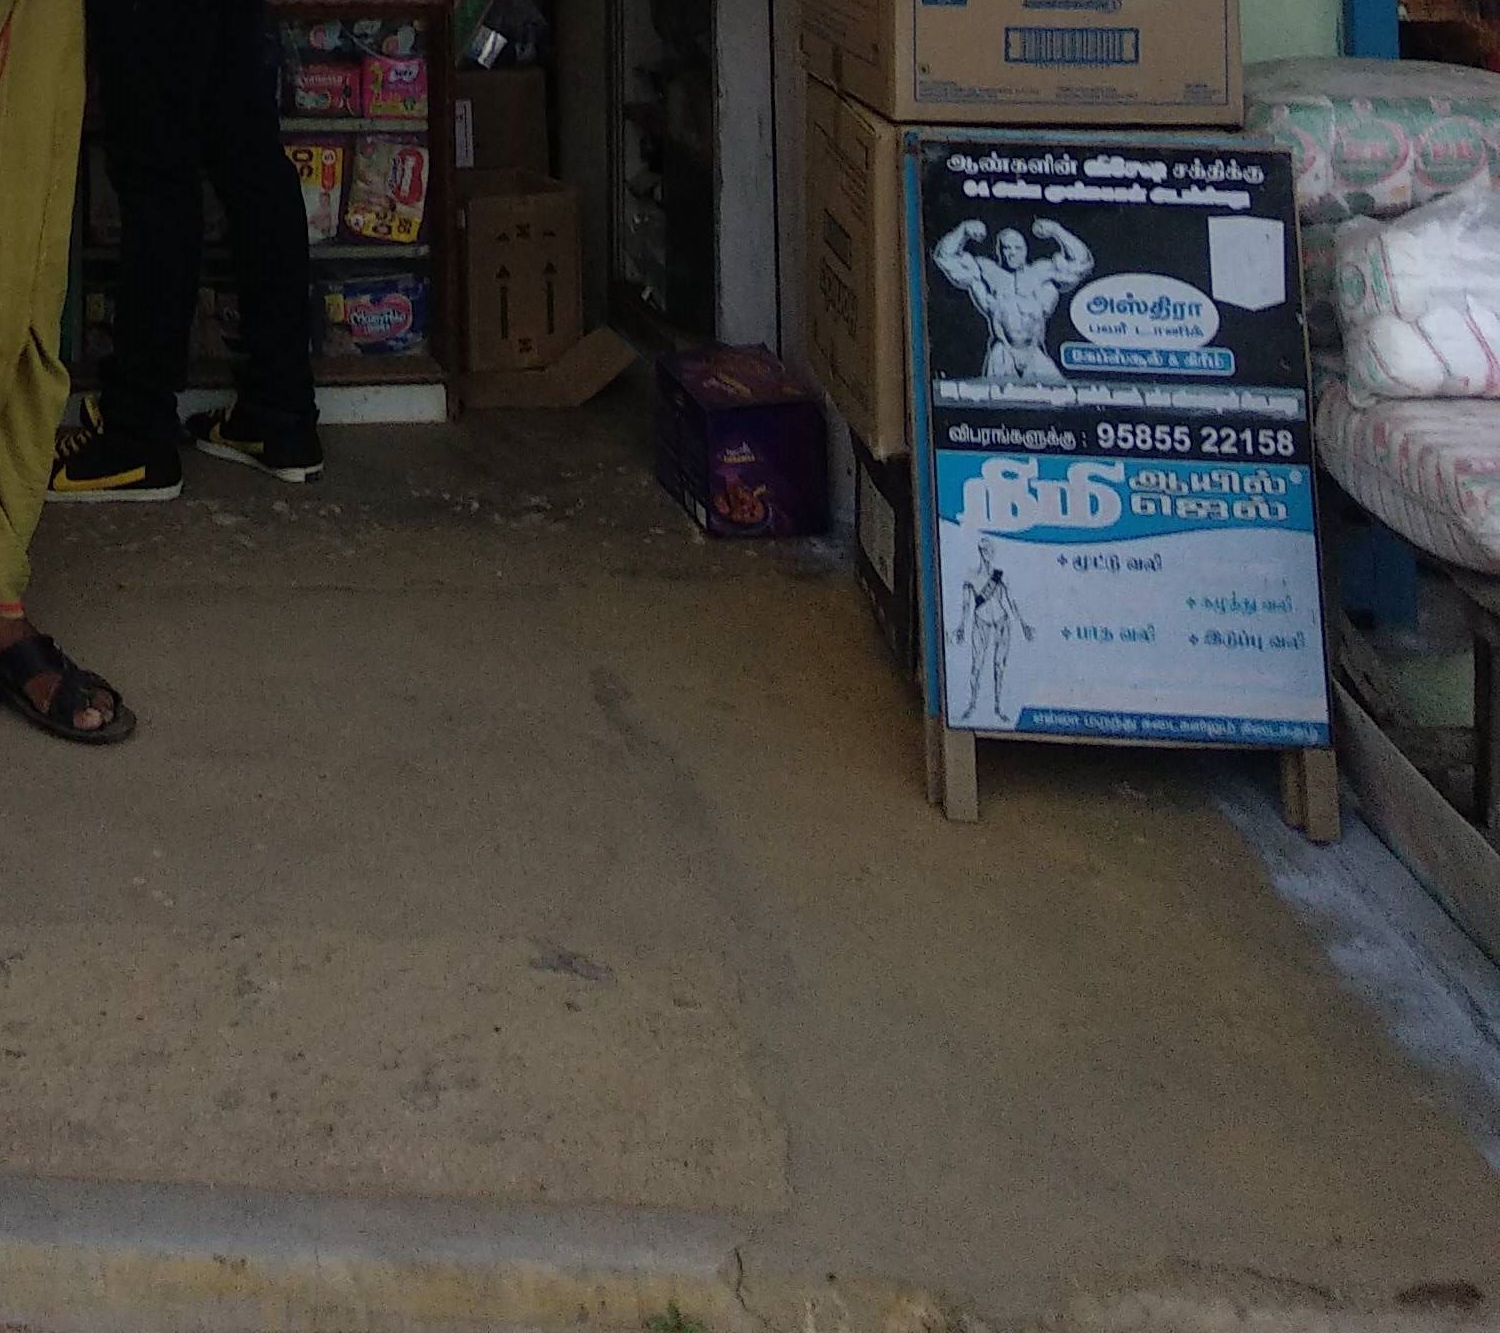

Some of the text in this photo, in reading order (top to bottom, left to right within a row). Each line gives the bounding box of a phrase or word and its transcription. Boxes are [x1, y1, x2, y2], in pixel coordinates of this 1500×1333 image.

[947, 151, 1078, 175] ஆண்களின்
[1173, 157, 1265, 184] சக்திக்கு
[1087, 293, 1203, 321] அஸ்திரா
[948, 424, 1078, 451] விபரங்களுக்கு
[1096, 421, 1192, 452] 95855
[1200, 426, 1295, 456] 22158
